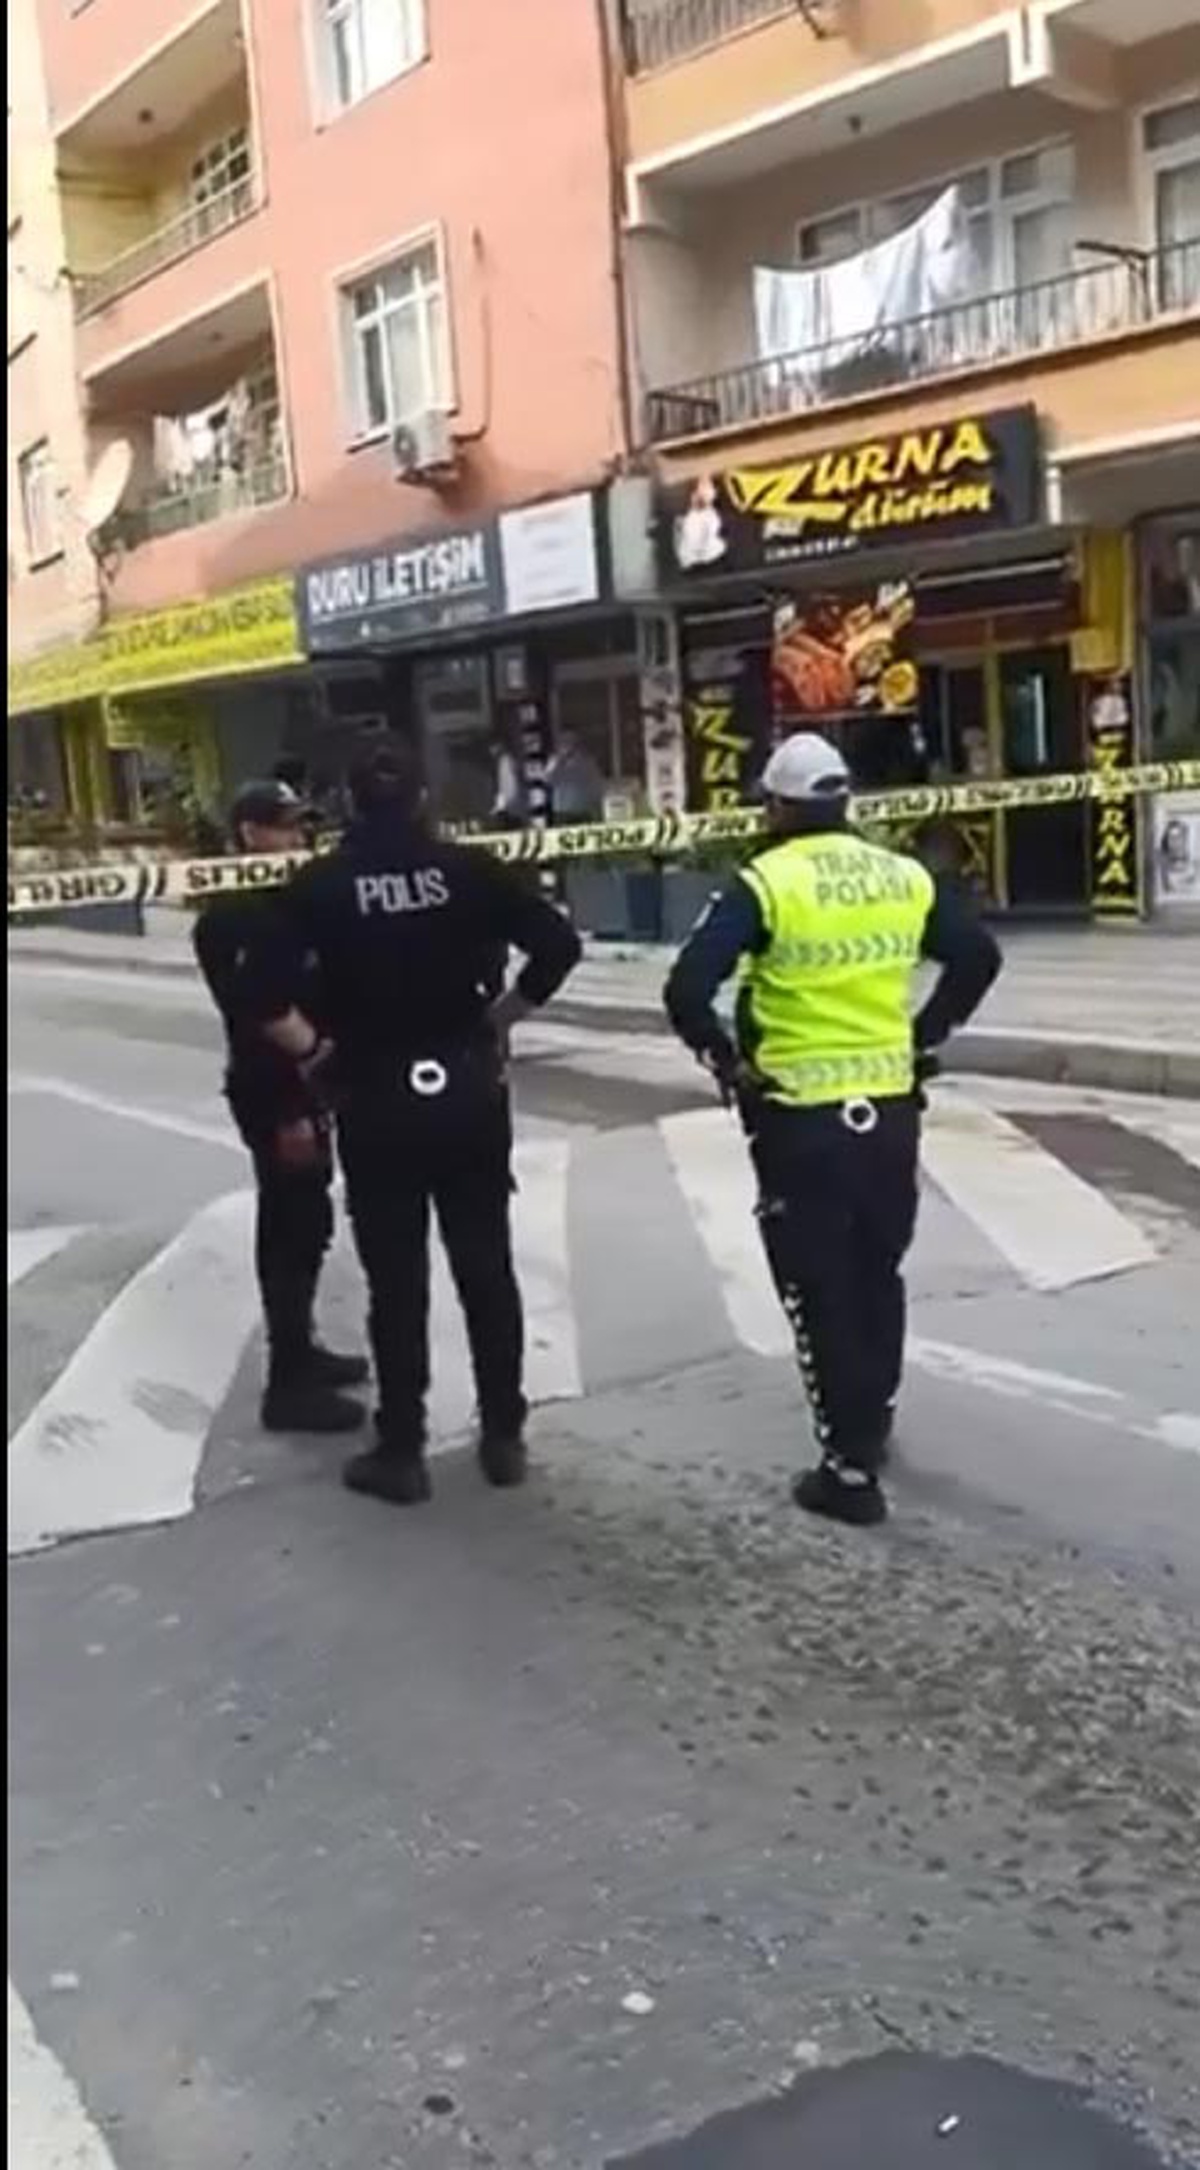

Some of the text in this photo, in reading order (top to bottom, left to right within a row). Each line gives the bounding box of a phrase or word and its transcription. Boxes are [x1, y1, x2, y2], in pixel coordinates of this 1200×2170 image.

[726, 421, 991, 521] ZURNA
[307, 563, 371, 615] DURU
[688, 702, 752, 816] ZUR
